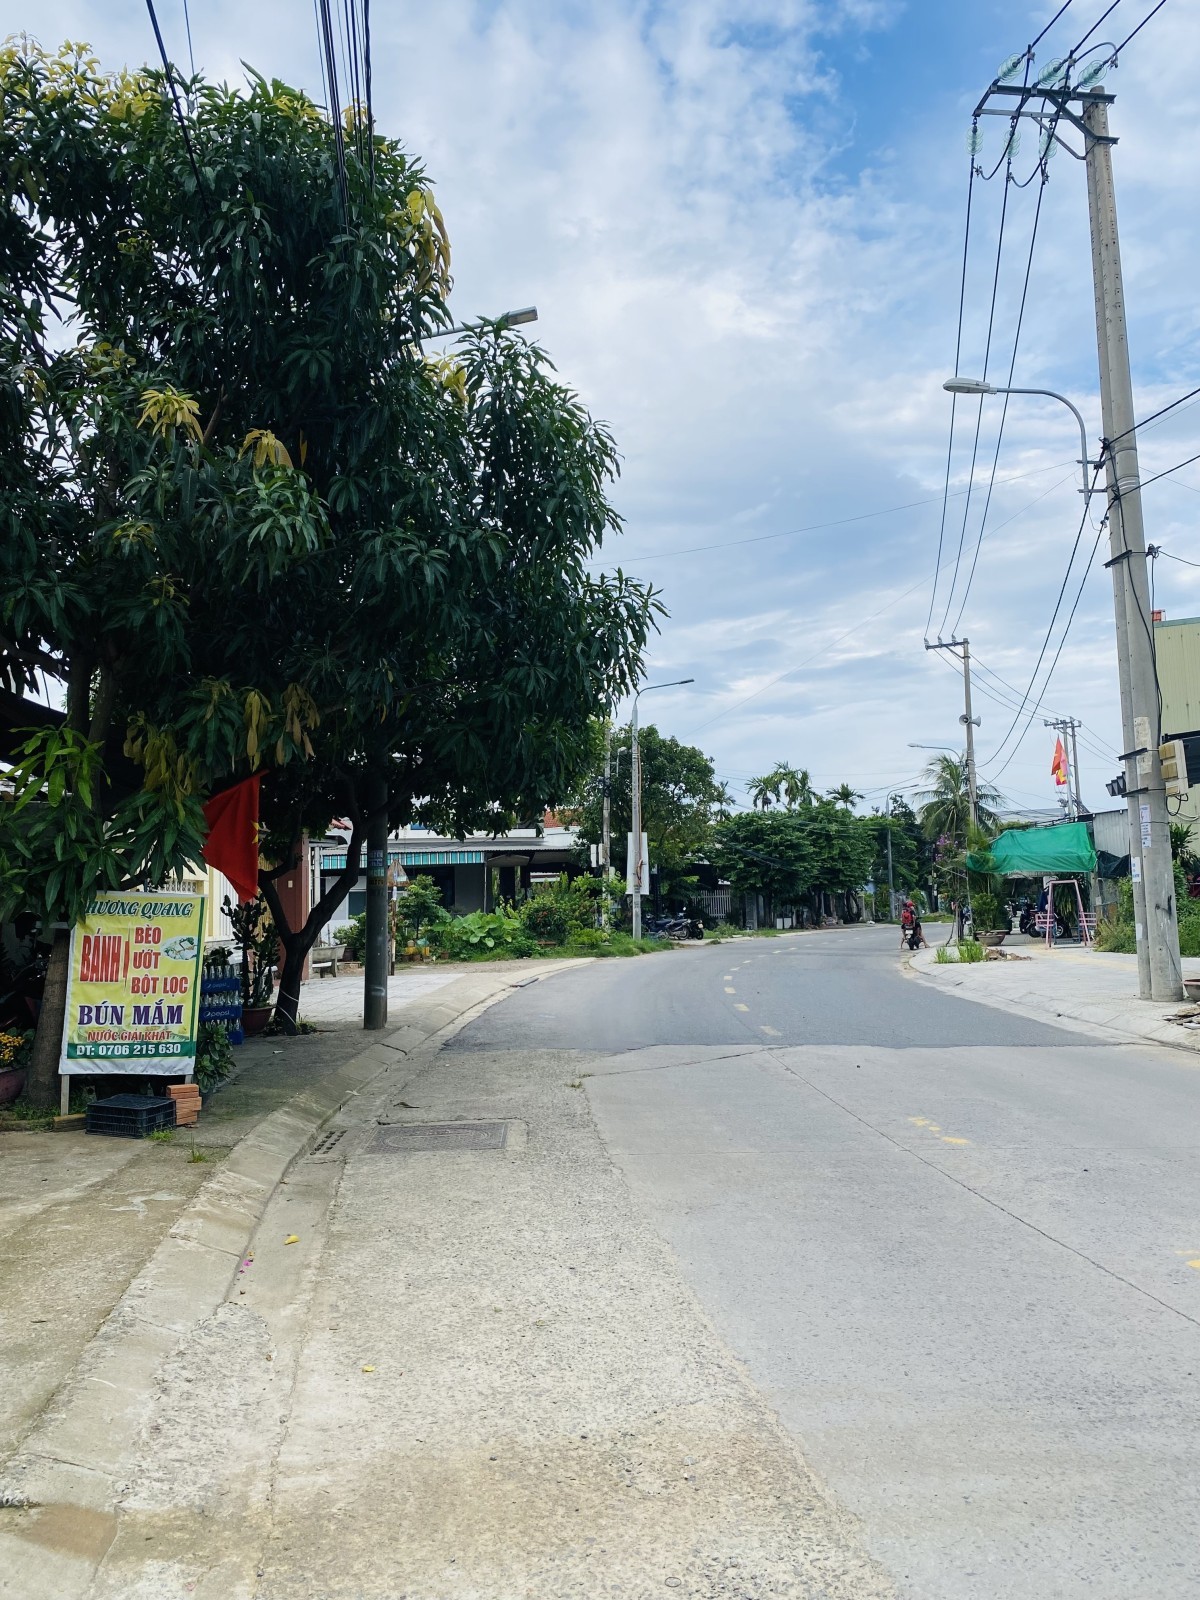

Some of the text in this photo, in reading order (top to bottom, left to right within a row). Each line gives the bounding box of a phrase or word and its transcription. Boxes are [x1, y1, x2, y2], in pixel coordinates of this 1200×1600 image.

[141, 902, 193, 920] QUANG
[134, 924, 162, 944] BÈO
[79, 928, 122, 982] BÁNH
[133, 949, 161, 969] ƯỚT
[131, 974, 188, 997] BỘT LỌC
[78, 999, 183, 1026] BÚN MẮM
[87, 1028, 172, 1042] NƯỚC GIẢI KHÁT
[76, 1043, 181, 1056] ĐT: 0706 215 630
